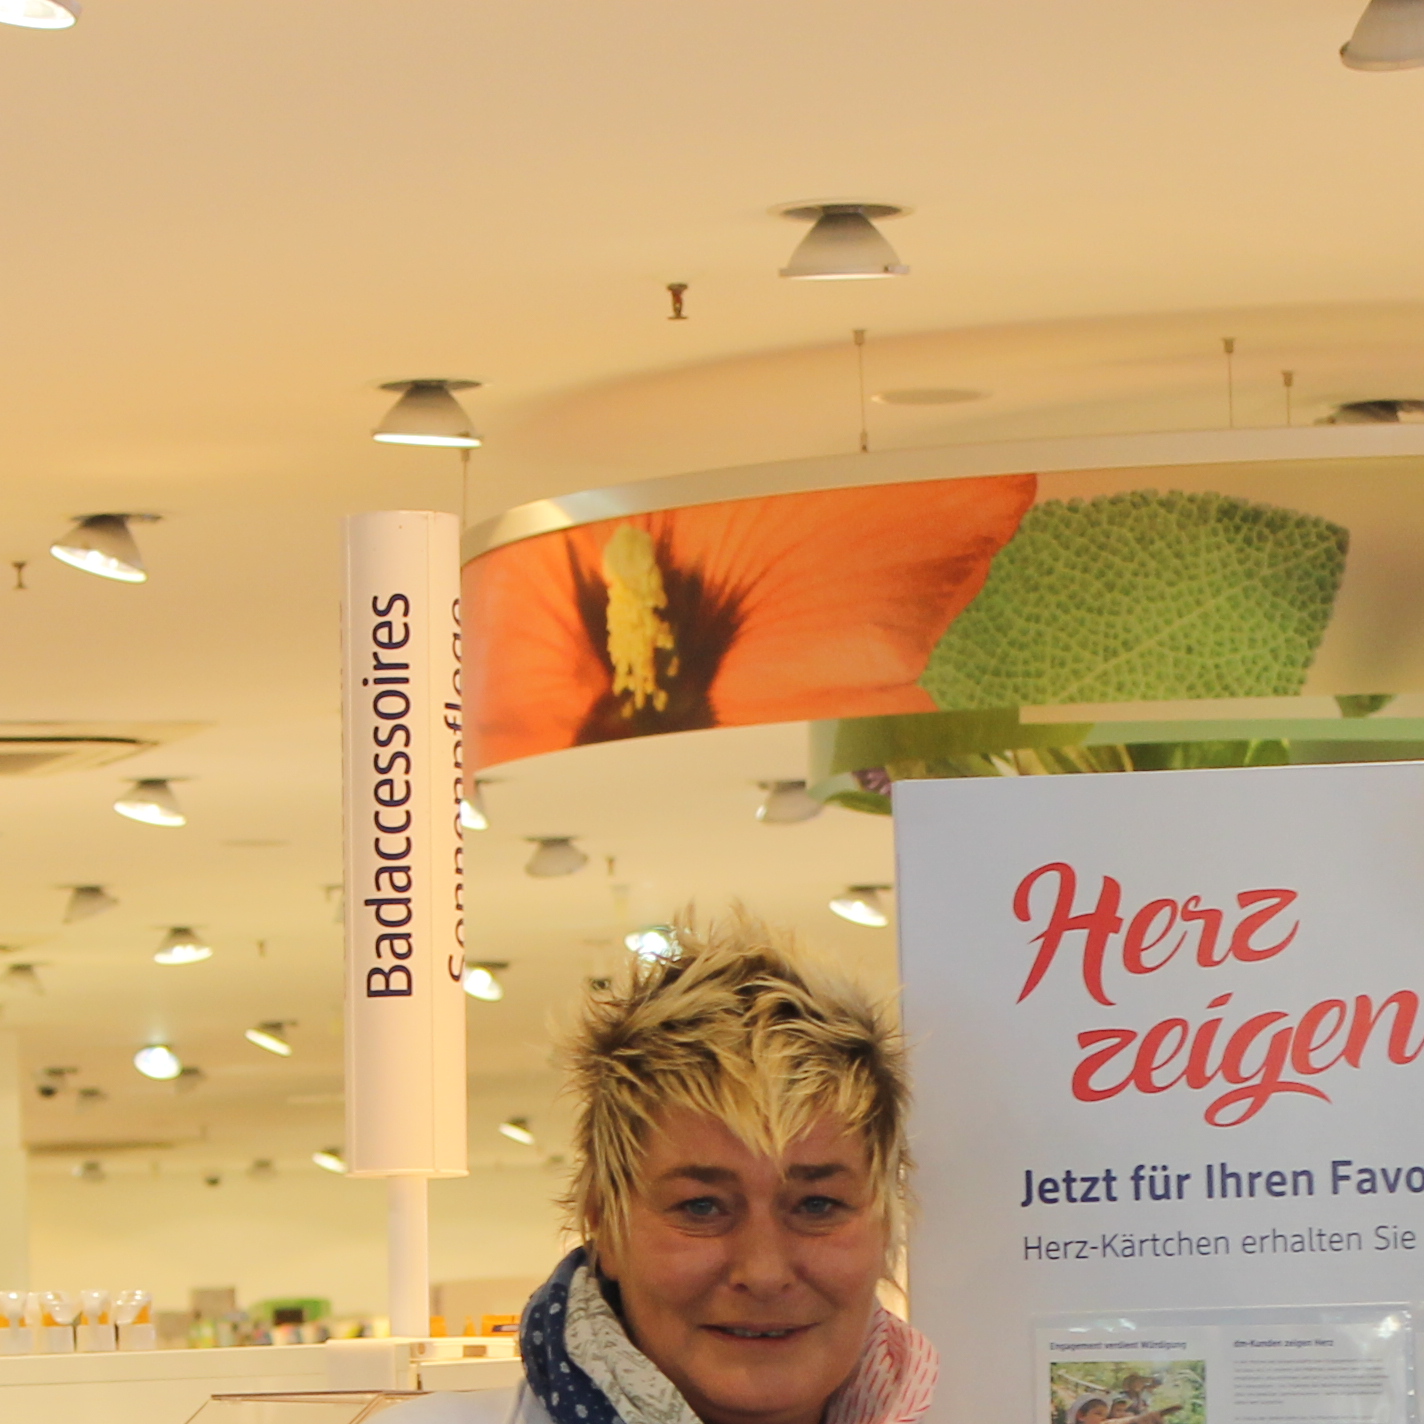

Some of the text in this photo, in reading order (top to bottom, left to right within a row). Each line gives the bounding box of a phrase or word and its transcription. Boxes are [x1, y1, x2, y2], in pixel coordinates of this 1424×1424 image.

[362, 592, 413, 998] Badaccessoires
[1012, 861, 1300, 1006] Herz
[1021, 1168, 1117, 1208] Jetzt
[1131, 1164, 1192, 1202] für
[1205, 1162, 1315, 1200] Ihren
[1023, 1228, 1231, 1262] Herz-Kärtchen
[1242, 1225, 1363, 1254] erhalten
[1375, 1224, 1417, 1252] Sie
